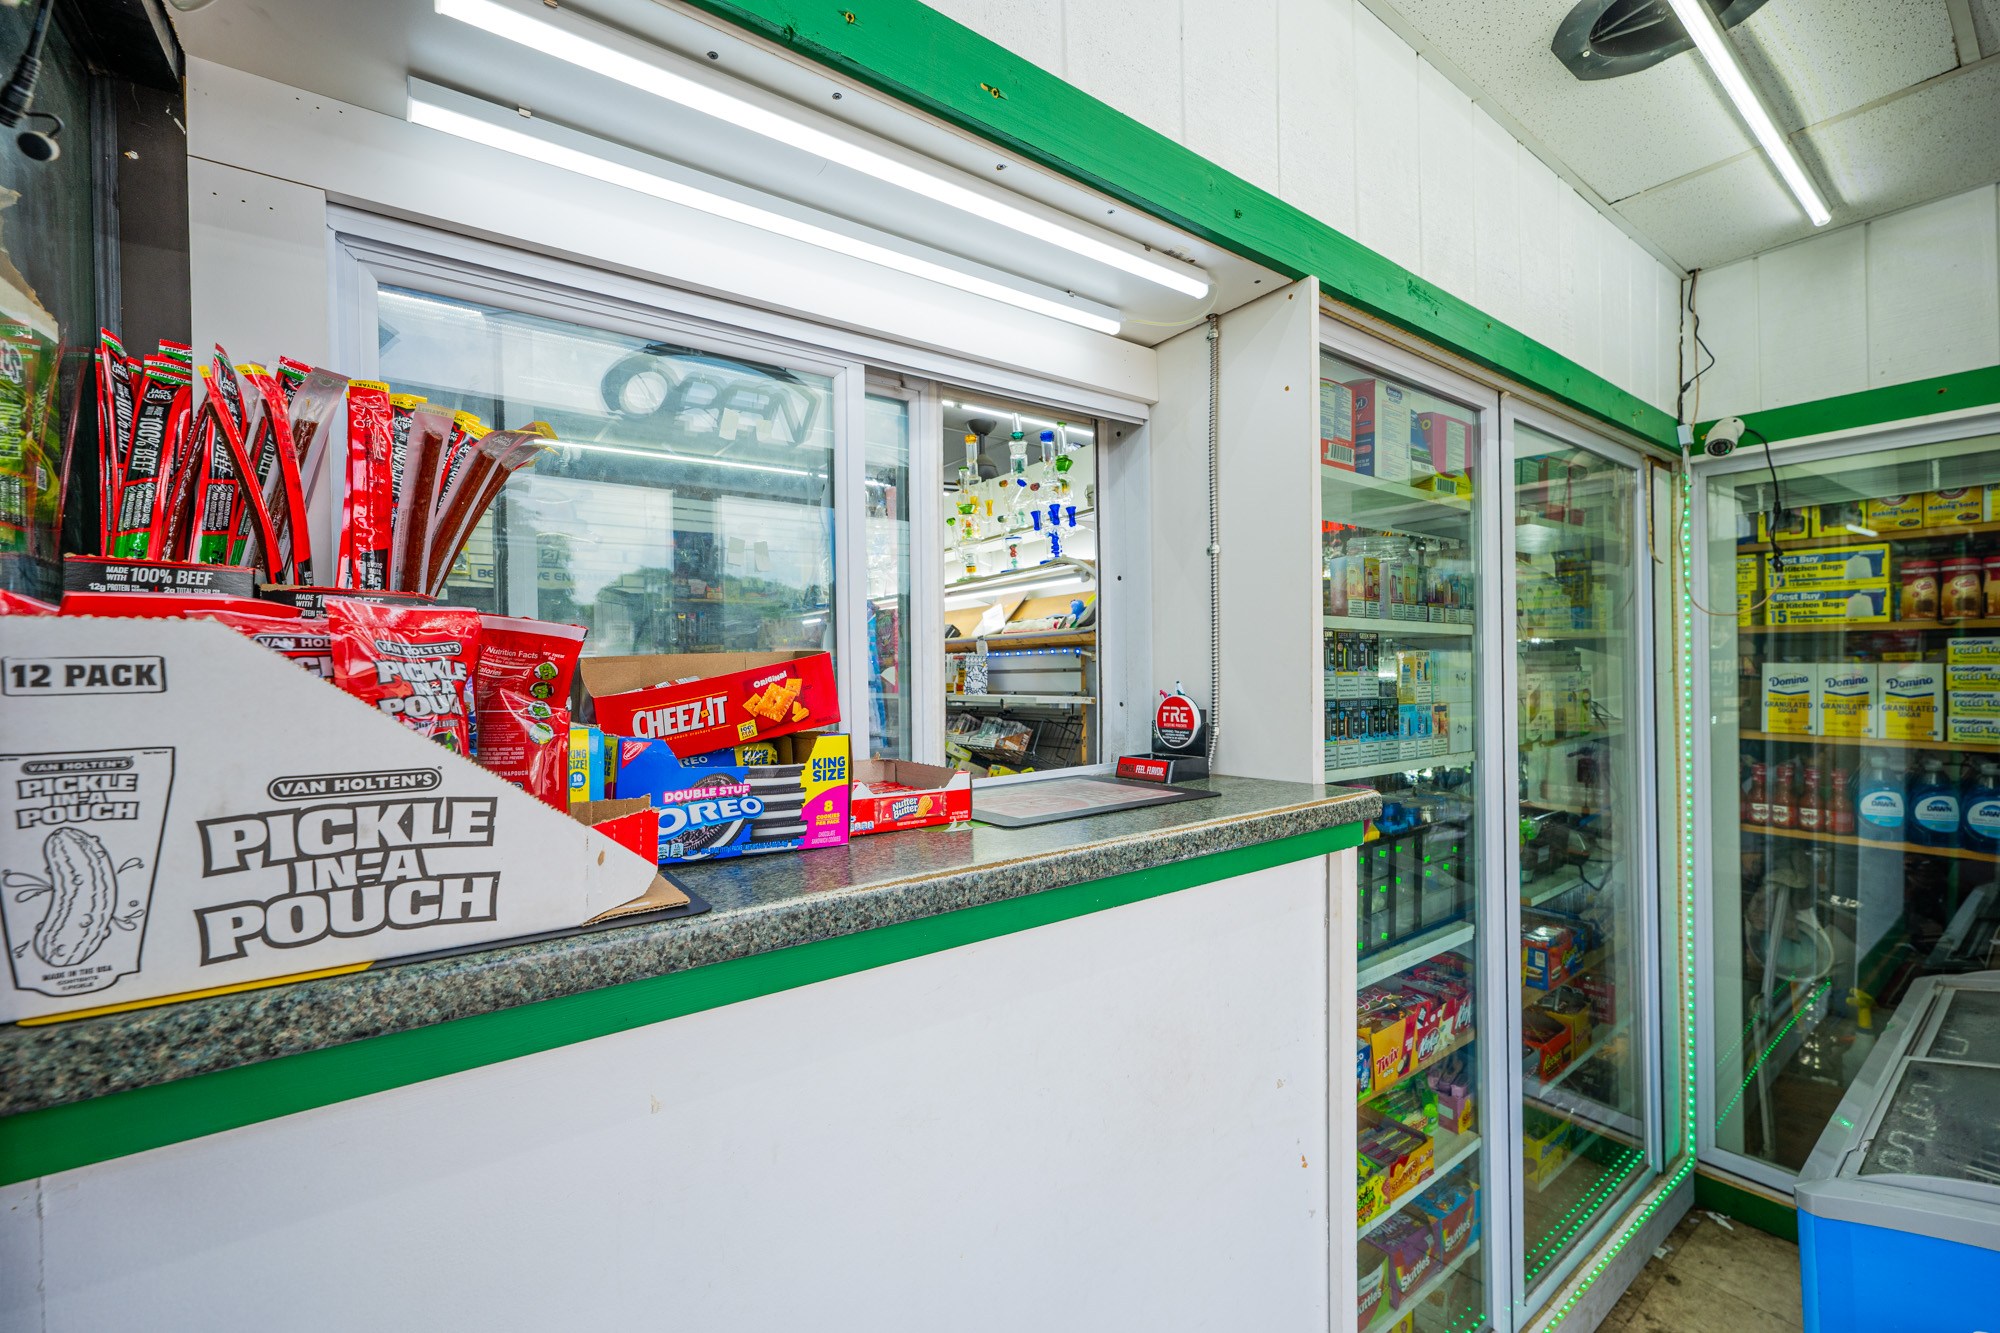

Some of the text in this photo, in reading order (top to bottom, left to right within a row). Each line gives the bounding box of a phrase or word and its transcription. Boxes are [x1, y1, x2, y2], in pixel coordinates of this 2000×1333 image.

[131, 448, 158, 476] BEEF
[1783, 555, 1819, 565] est Buy
[106, 566, 129, 574] MADE
[1785, 565, 1818, 573] Kitchen
[106, 573, 127, 581] WITH
[130, 567, 214, 586] 100% BEEF
[88, 582, 130, 592] 12g PROTEIN
[1776, 592, 1820, 601] Best Buy
[295, 600, 313, 608] WITH
[1769, 610, 1787, 624] 15
[379, 641, 460, 656] VAN HOLTEN'S
[486, 646, 517, 657] Nutrition
[518, 651, 539, 659] Facts
[1954, 646, 1982, 654] Fold
[11, 663, 157, 688] 12 PACK
[374, 660, 468, 685] PICKLE
[1768, 674, 1810, 688] Domino
[1825, 674, 1869, 689] Domino
[1886, 675, 1934, 690] Domino
[1764, 700, 1813, 709] GRANULATED
[1820, 702, 1873, 711] GRANULATED
[1881, 703, 1938, 713] GRANULATED
[1954, 699, 1983, 707] Fold
[1162, 706, 1189, 723] FRE
[742, 749, 769, 759] KING
[27, 760, 129, 773] VAN HOLTEN'S
[680, 756, 708, 767] REO
[742, 757, 769, 767] SIZE
[812, 756, 846, 770] KING
[572, 774, 583, 783] 10
[812, 768, 846, 783] SIZE
[16, 773, 139, 800] PICKLE
[276, 772, 434, 796] VAN HOLTEN'S
[664, 784, 750, 804] DOUBLE STUF
[823, 800, 834, 812] 8
[892, 797, 919, 812] Nutter
[1871, 800, 1897, 808] DAWN
[1926, 805, 1952, 813] DAWN
[16, 801, 140, 830] POUCH
[658, 798, 762, 837] OREO
[816, 812, 840, 820] COOKIES
[893, 804, 919, 820] Butter
[1978, 809, 2000, 818] DAW
[196, 796, 498, 879] PICKLE
[193, 871, 501, 967] POUCH
[1444, 1219, 1471, 1253] Skittles
[1400, 1255, 1430, 1293] Skittles
[1358, 1287, 1382, 1316] kittles
